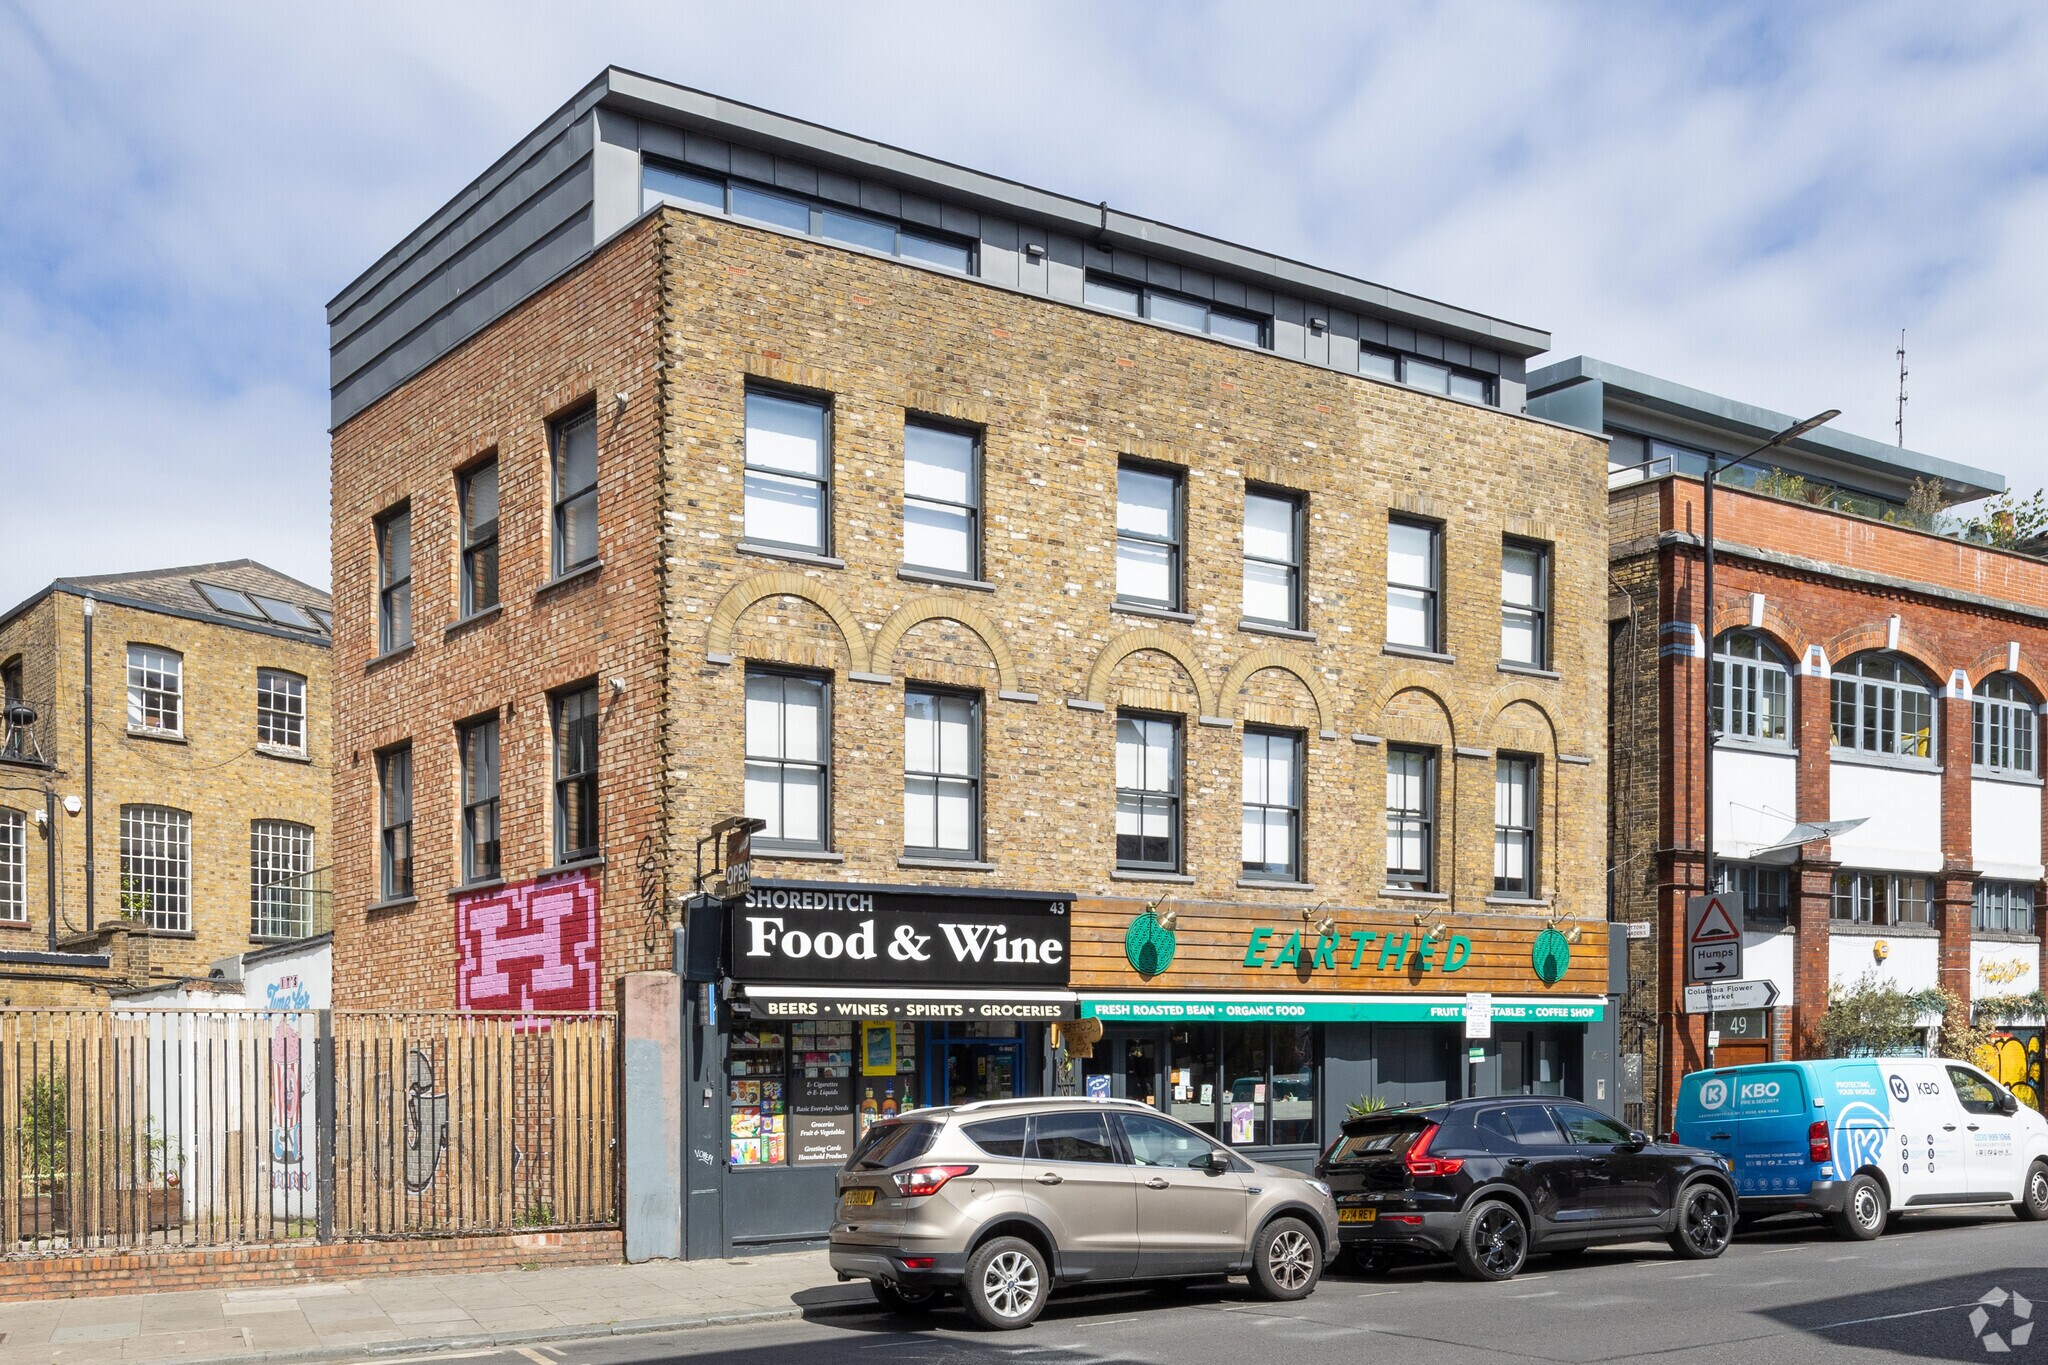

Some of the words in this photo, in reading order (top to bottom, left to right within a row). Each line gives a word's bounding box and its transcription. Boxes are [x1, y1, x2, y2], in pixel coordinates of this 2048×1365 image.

[727, 861, 750, 885] OPEN
[745, 890, 874, 912] SHOREDITCH
[1049, 902, 1065, 915] 43
[745, 917, 878, 960] Food
[888, 924, 931, 961] &
[938, 923, 1064, 965] Wine
[1243, 927, 1472, 973] EARTHED
[1698, 948, 1734, 959] Humps
[1687, 986, 1724, 995] Columbia
[1727, 984, 1753, 993] Flower
[1707, 993, 1734, 1001] Market
[768, 1002, 818, 1015] BEERS
[836, 1003, 889, 1016] WINES
[906, 1004, 963, 1017] SPIRITS
[980, 1004, 1061, 1018] GROCERIES
[1095, 1004, 1130, 1015] FRESH
[1133, 1005, 1185, 1016] ROASTED
[1187, 1005, 1215, 1016] BEAN
[1226, 1006, 1274, 1017] ORGANIC
[1276, 1006, 1305, 1017] FOOD
[1430, 1007, 1460, 1018] FRUIT
[1535, 1007, 1568, 1018] COFFEE
[1570, 1007, 1595, 1018] SHOP
[1730, 1016, 1747, 1034] 49
[813, 1081, 839, 1090] Cigarettes
[1741, 1081, 1780, 1099] KBO
[1916, 1082, 1940, 1095] KBO
[818, 1089, 839, 1097] Liquids
[1837, 1088, 1854, 1096] YOUR
[810, 1105, 833, 1114] Everyday
[834, 1104, 849, 1112] Needs
[820, 1128, 845, 1137] Vegetables
[1988, 1133, 1998, 1142] 999
[1998, 1133, 2012, 1141] 1066
[804, 1144, 826, 1153] Greeting
[826, 1144, 842, 1152] Cards
[798, 1153, 820, 1161] Household
[820, 1152, 848, 1160] Products
[1358, 1209, 1374, 1220] REY
